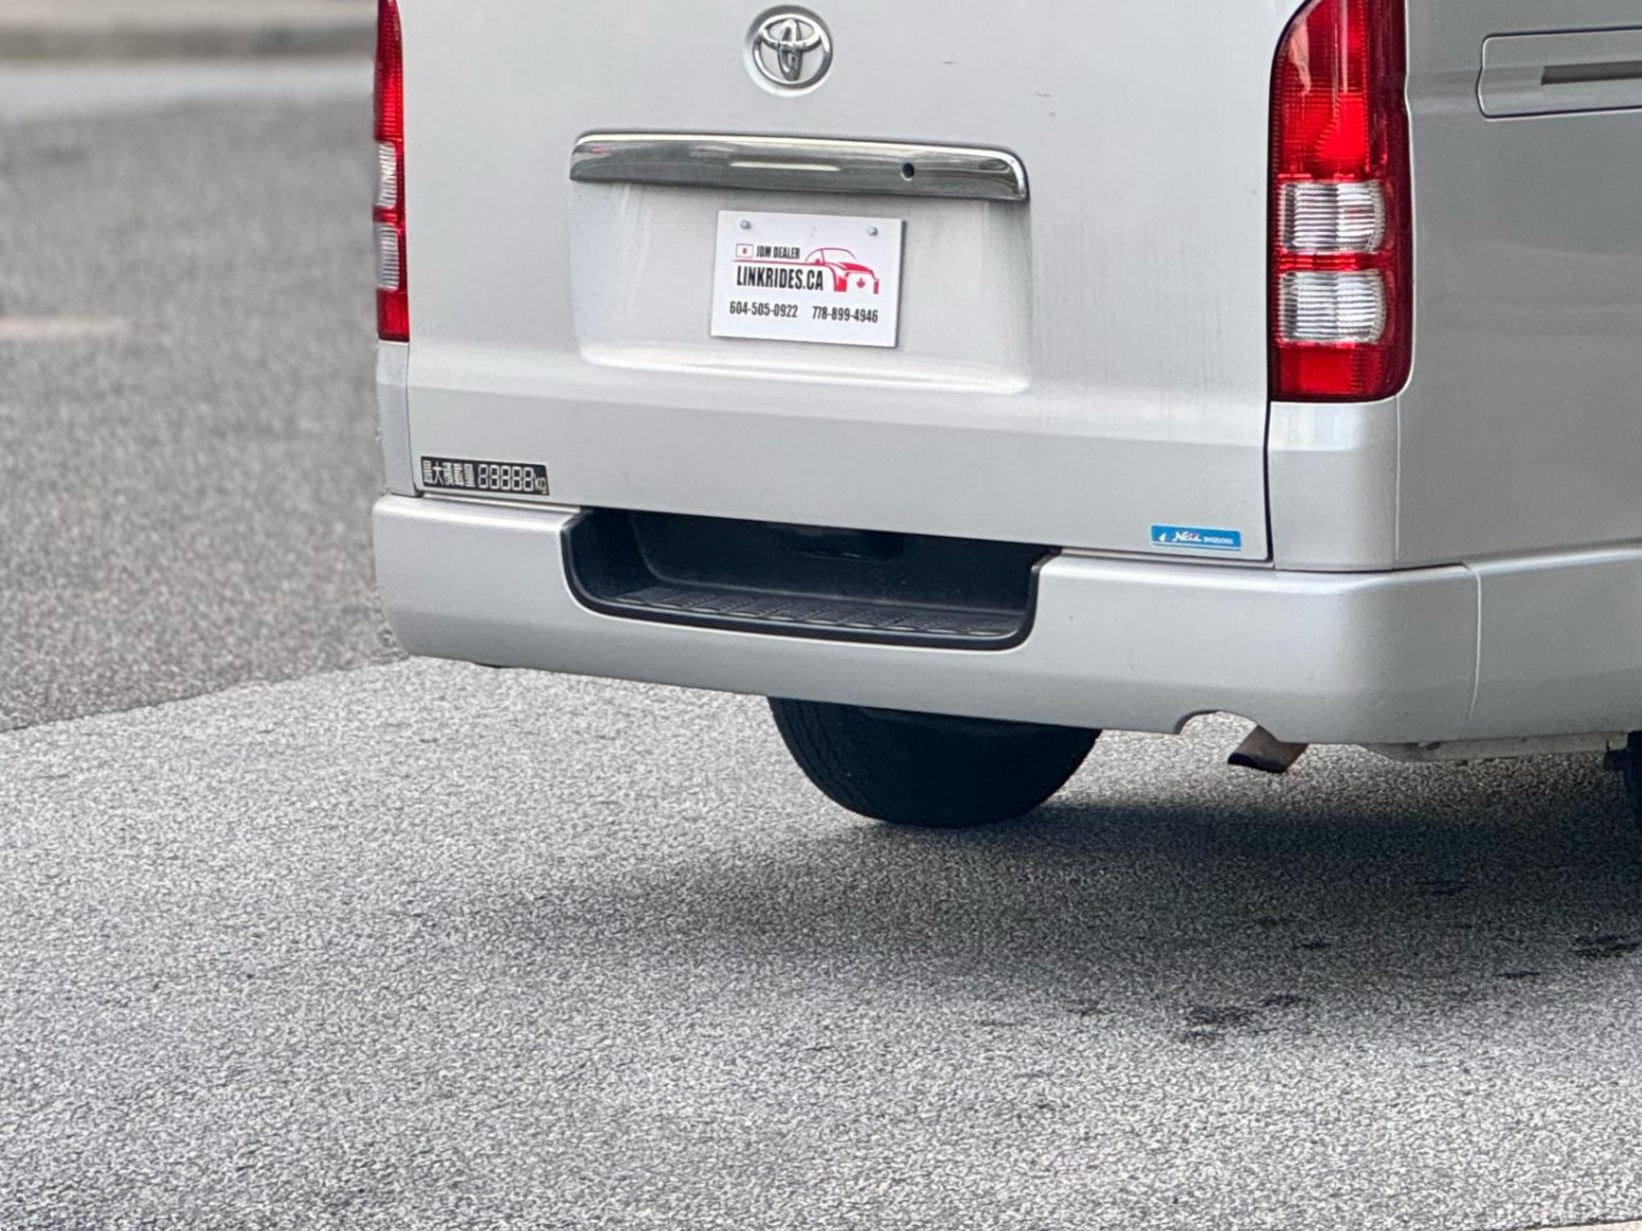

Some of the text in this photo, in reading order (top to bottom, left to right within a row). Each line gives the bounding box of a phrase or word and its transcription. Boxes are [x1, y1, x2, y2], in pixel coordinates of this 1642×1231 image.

[755, 245, 800, 259] JDM DEALER
[736, 265, 824, 291] LINKRIDES.CA
[729, 300, 879, 323] 604-505-0922 778-899-4946
